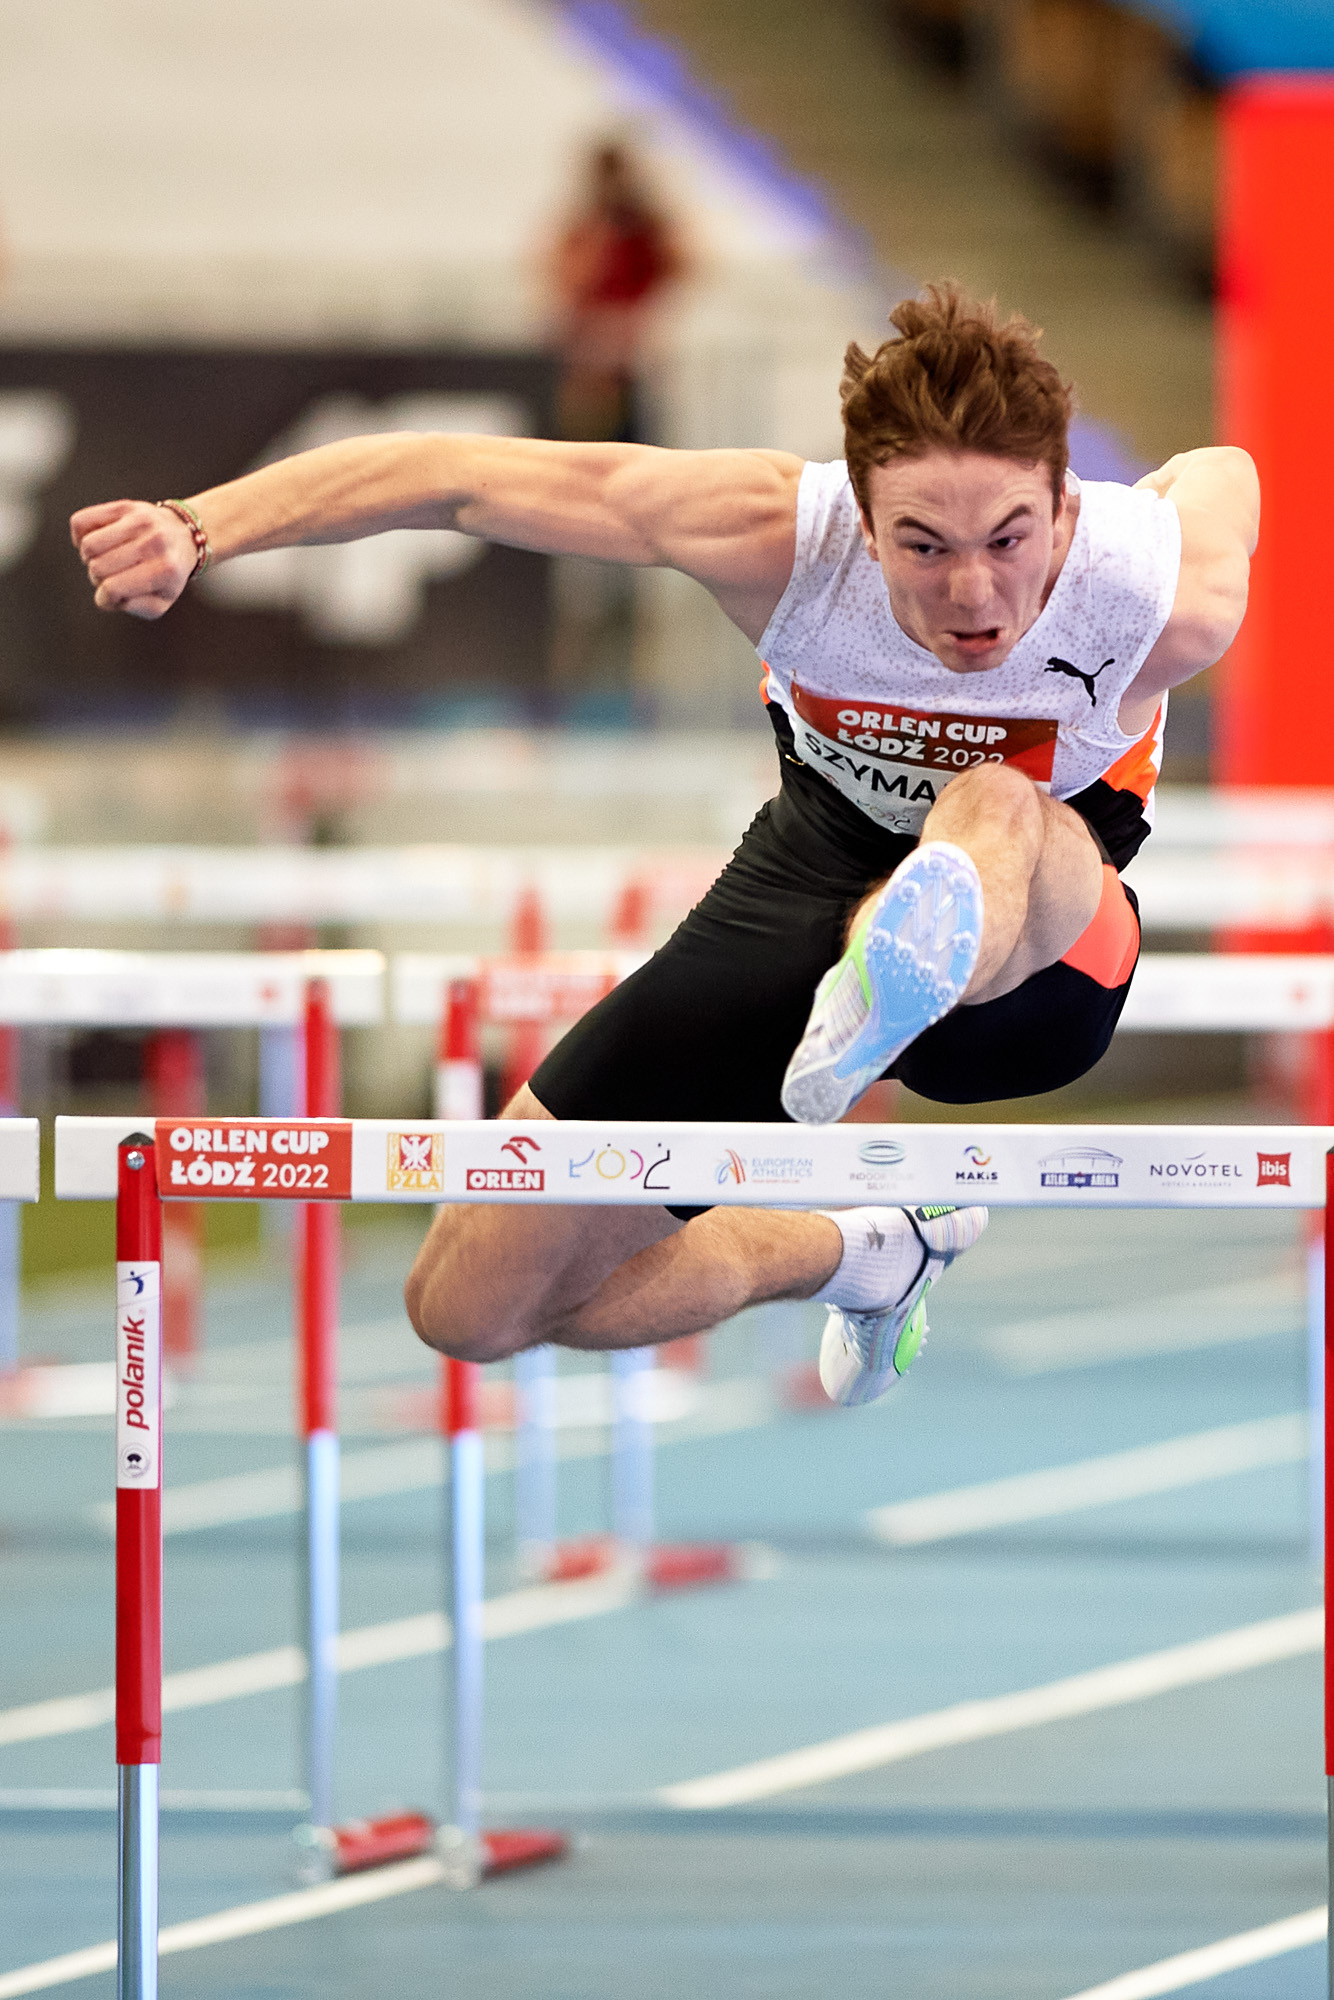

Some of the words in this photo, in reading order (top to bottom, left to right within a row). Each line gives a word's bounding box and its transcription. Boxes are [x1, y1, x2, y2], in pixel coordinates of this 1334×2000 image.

[837, 709, 940, 739] ORLEN
[945, 722, 1007, 745] CUP
[837, 728, 926, 760] ŁÓDŹ
[805, 732, 946, 807] SZYMA
[169, 1127, 268, 1154] ORLEN
[271, 1130, 329, 1155] CUP
[170, 1154, 256, 1186] ŁÓDŹ
[262, 1163, 329, 1188] 2022
[752, 1158, 813, 1167] EUROPEAN
[752, 1168, 813, 1178] ATHLETICS
[1150, 1164, 1243, 1177] NOVOTEL
[1261, 1160, 1287, 1176] ibis
[390, 1171, 440, 1189] PZLA
[469, 1171, 541, 1189] ORLEN
[122, 1316, 150, 1430] polanik
